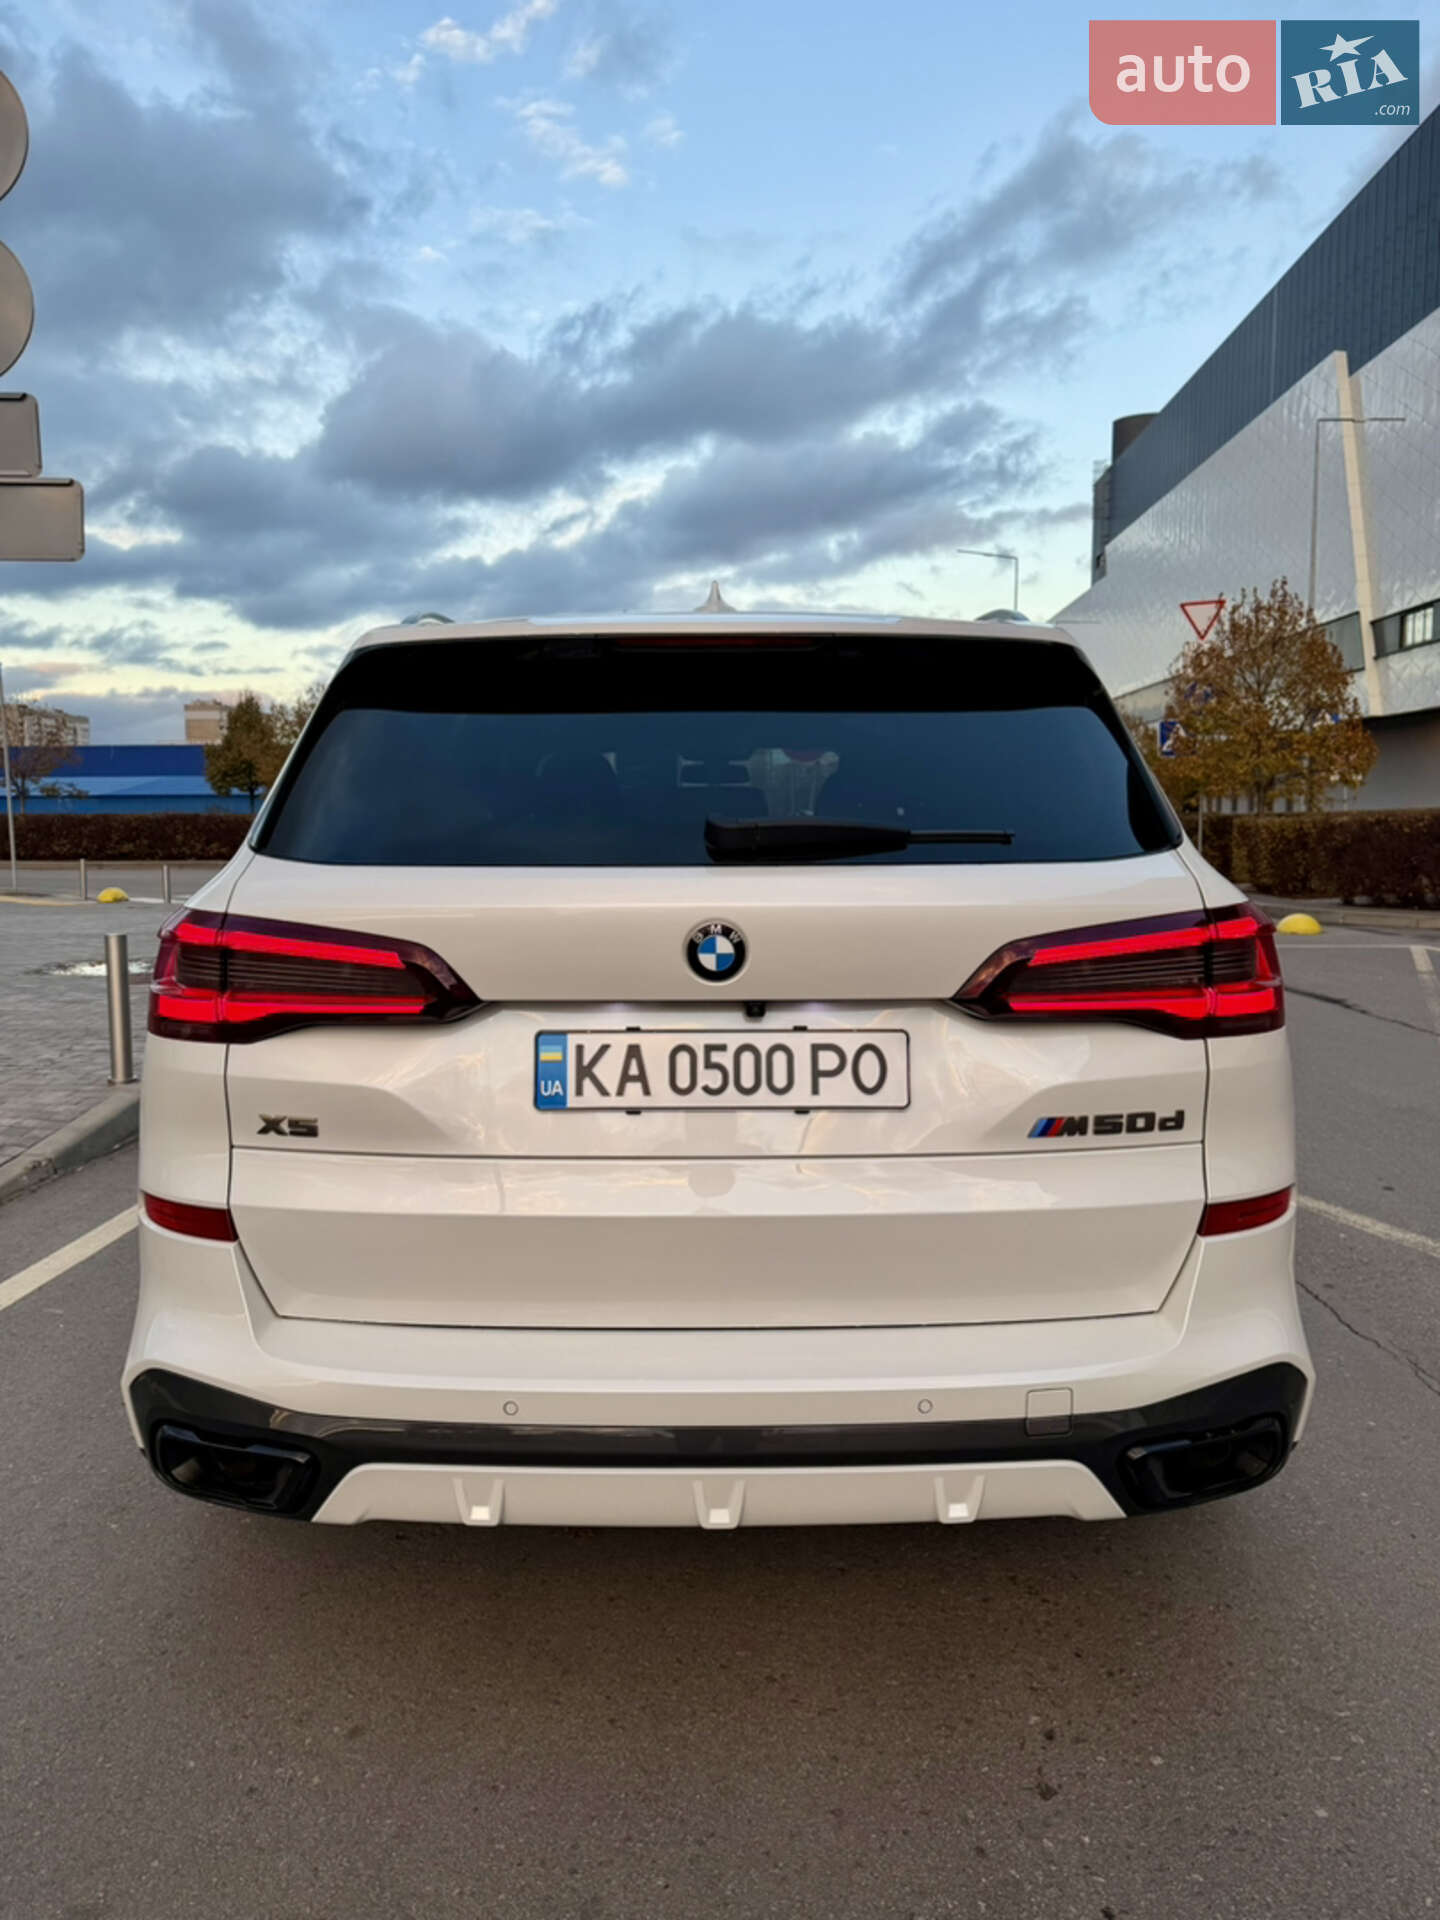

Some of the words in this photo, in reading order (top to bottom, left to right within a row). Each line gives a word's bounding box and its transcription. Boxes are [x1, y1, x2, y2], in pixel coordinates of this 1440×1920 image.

[691, 923, 742, 944] BMW
[574, 1043, 652, 1098] KA
[668, 1043, 795, 1096] 0500
[810, 1043, 888, 1096] PO
[540, 1080, 563, 1097] UA
[256, 1113, 319, 1138] X5
